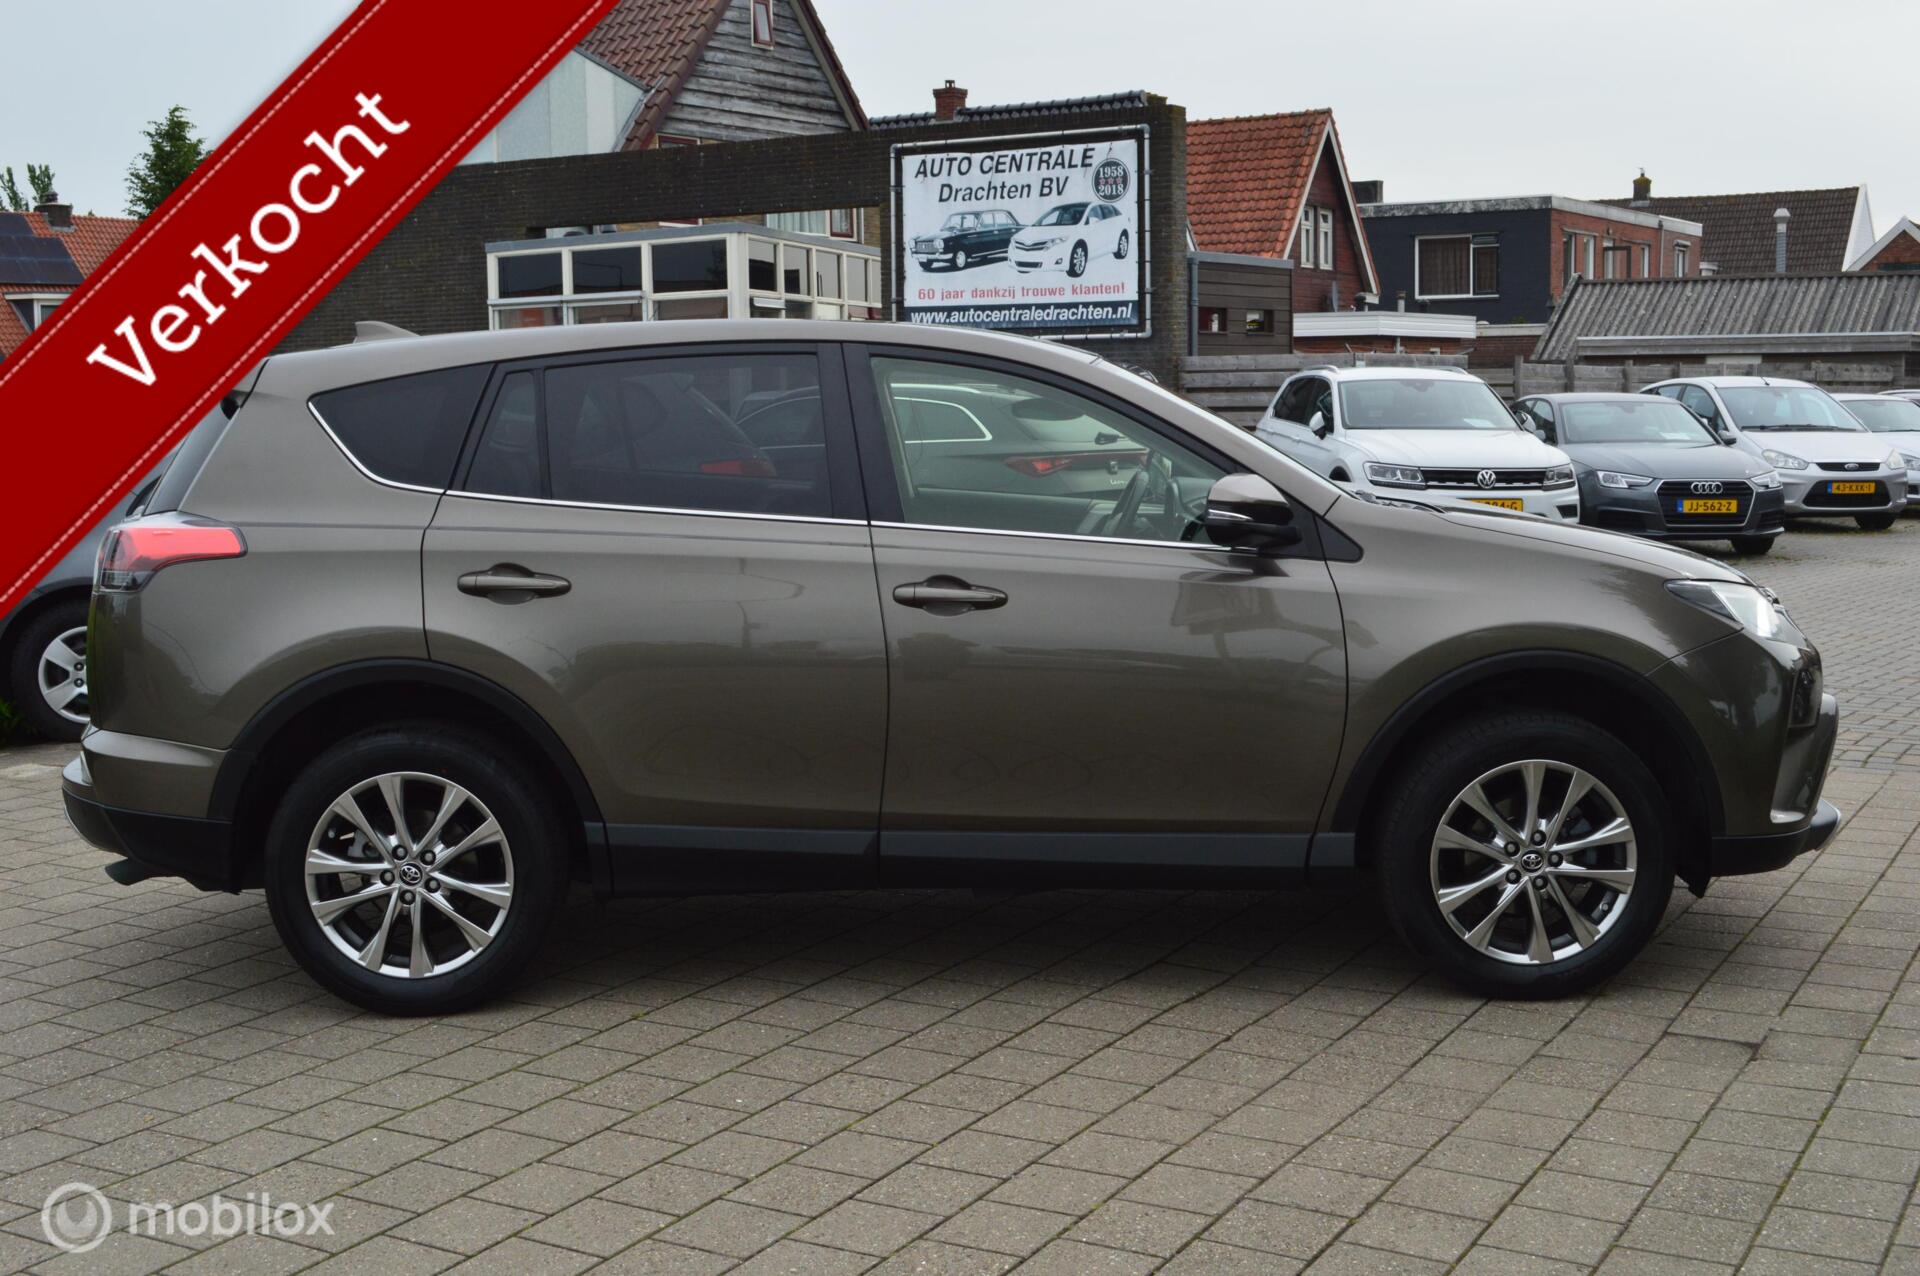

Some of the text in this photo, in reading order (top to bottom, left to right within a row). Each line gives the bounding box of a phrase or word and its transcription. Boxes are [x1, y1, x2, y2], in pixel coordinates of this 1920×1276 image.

[914, 148, 1096, 178] AUTO CENTRALE
[1098, 165, 1124, 178] 1958
[938, 176, 1069, 203] Drachten BV
[1098, 184, 1124, 196] 2018
[917, 282, 1126, 301] 60 jaar dankzij trouwe klanten!
[911, 303, 1133, 324] www.autocentraledrachten.nl
[1687, 501, 1732, 512] JJ-562-Z
